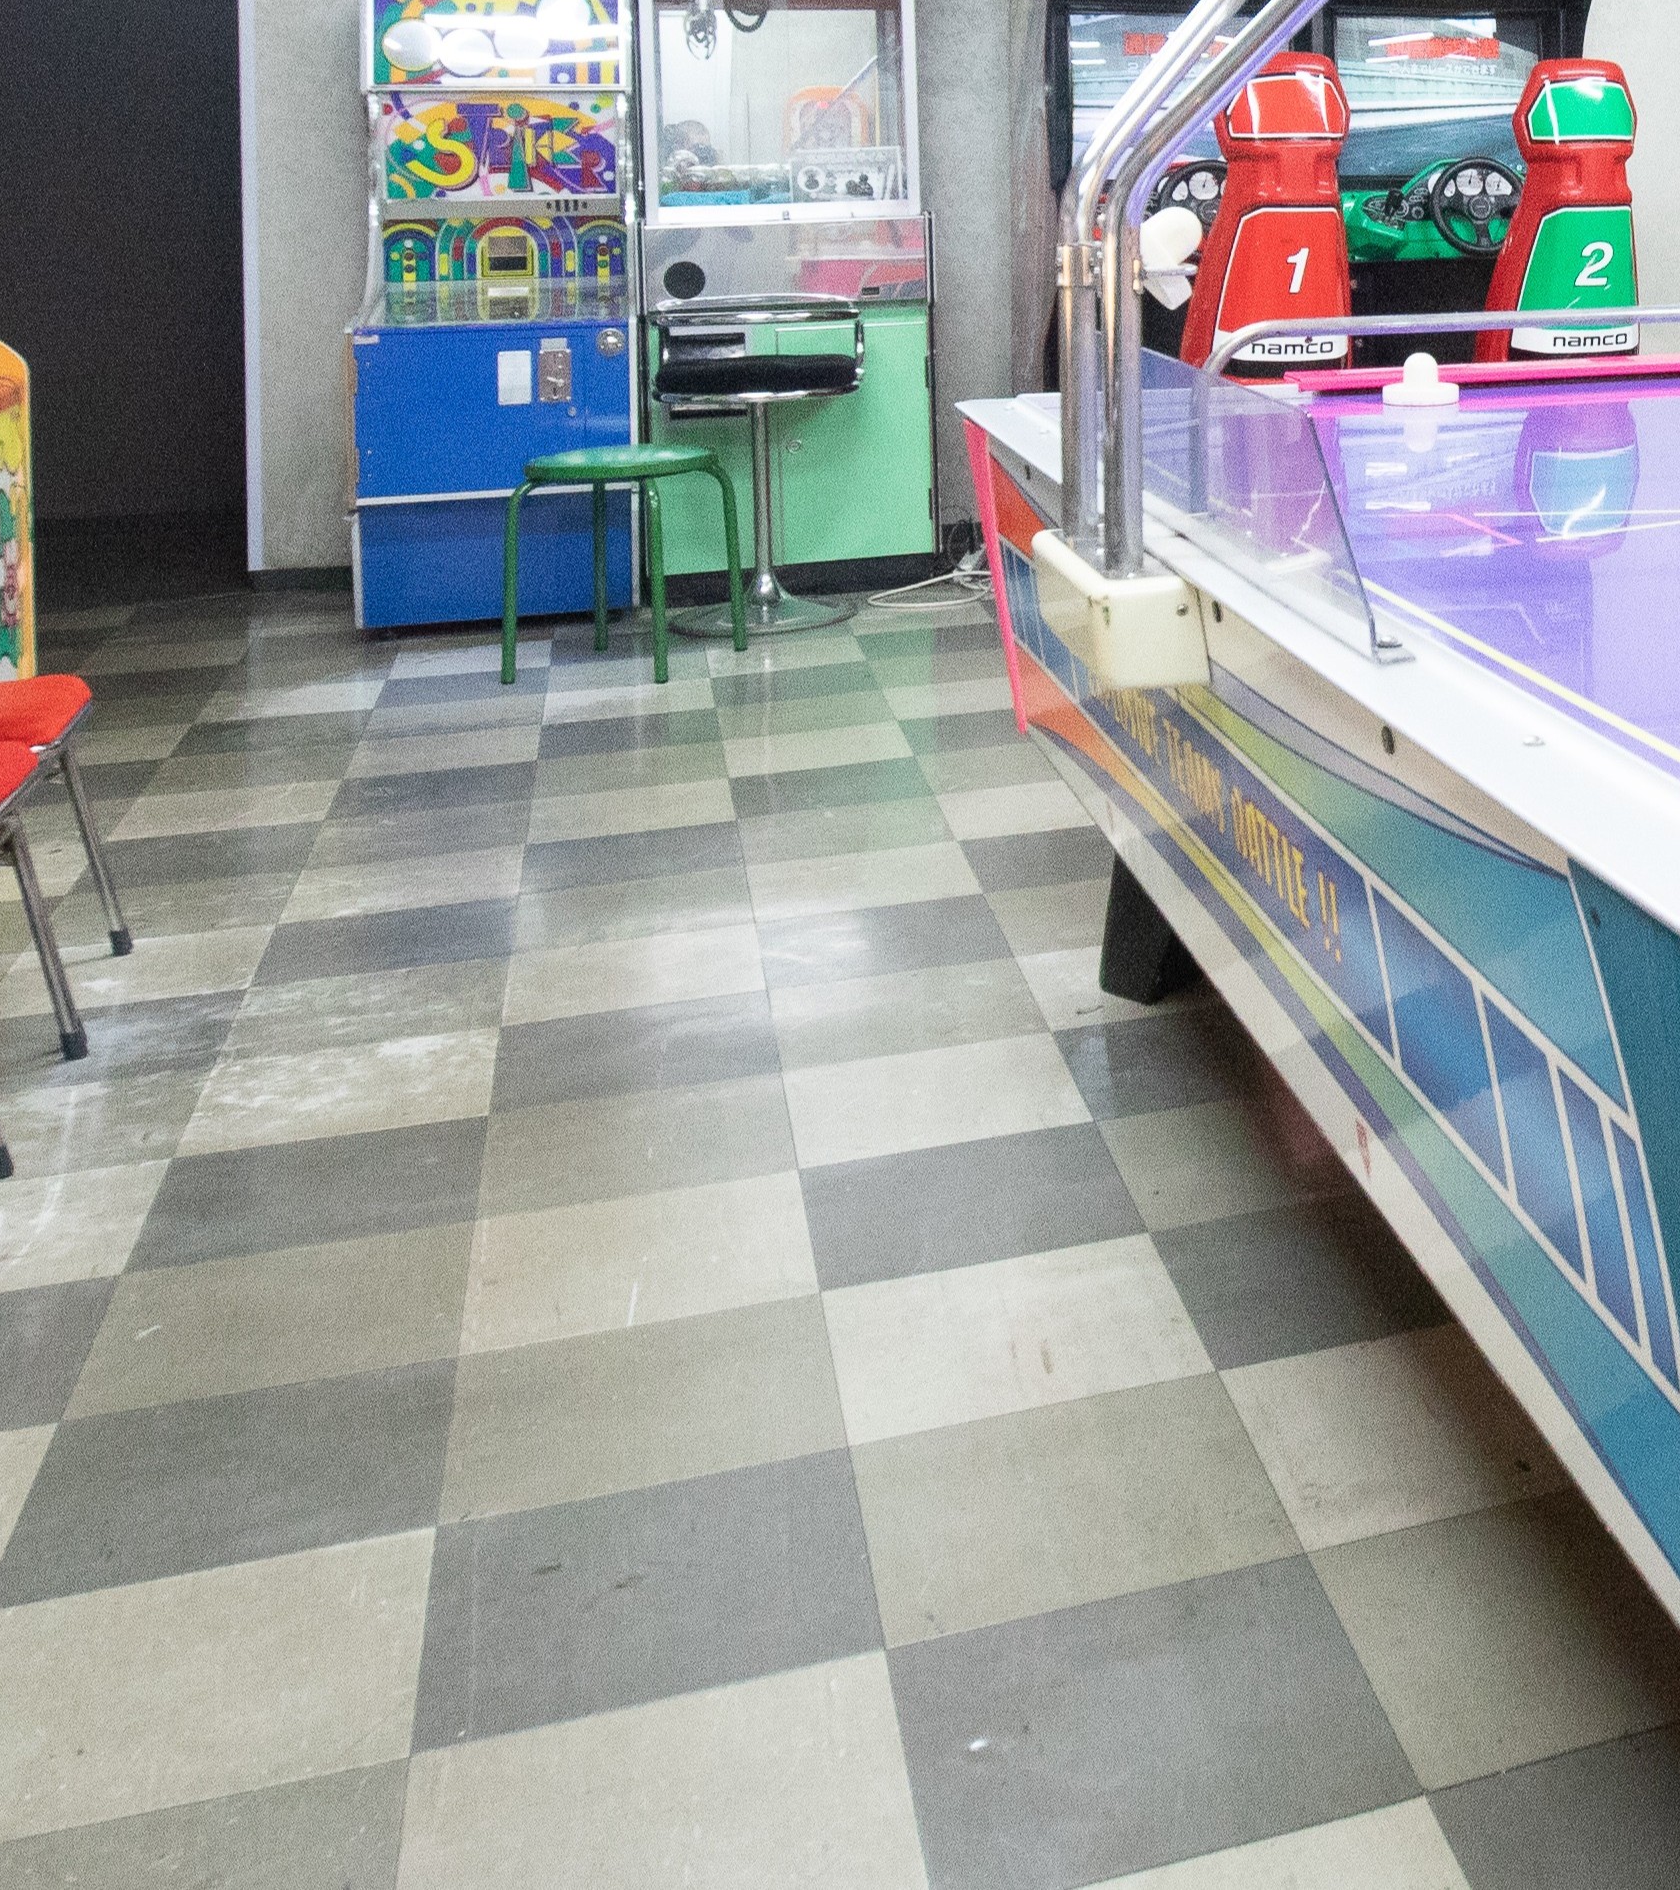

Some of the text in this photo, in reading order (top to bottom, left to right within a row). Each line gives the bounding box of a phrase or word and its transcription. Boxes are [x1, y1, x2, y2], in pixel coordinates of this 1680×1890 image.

[405, 102, 608, 194] STRIKER
[1285, 248, 1311, 293] 1
[1574, 241, 1615, 288] 2
[1250, 337, 1334, 357] namco
[1551, 329, 1629, 348] namco
[1231, 784, 1310, 929] BATTLE
